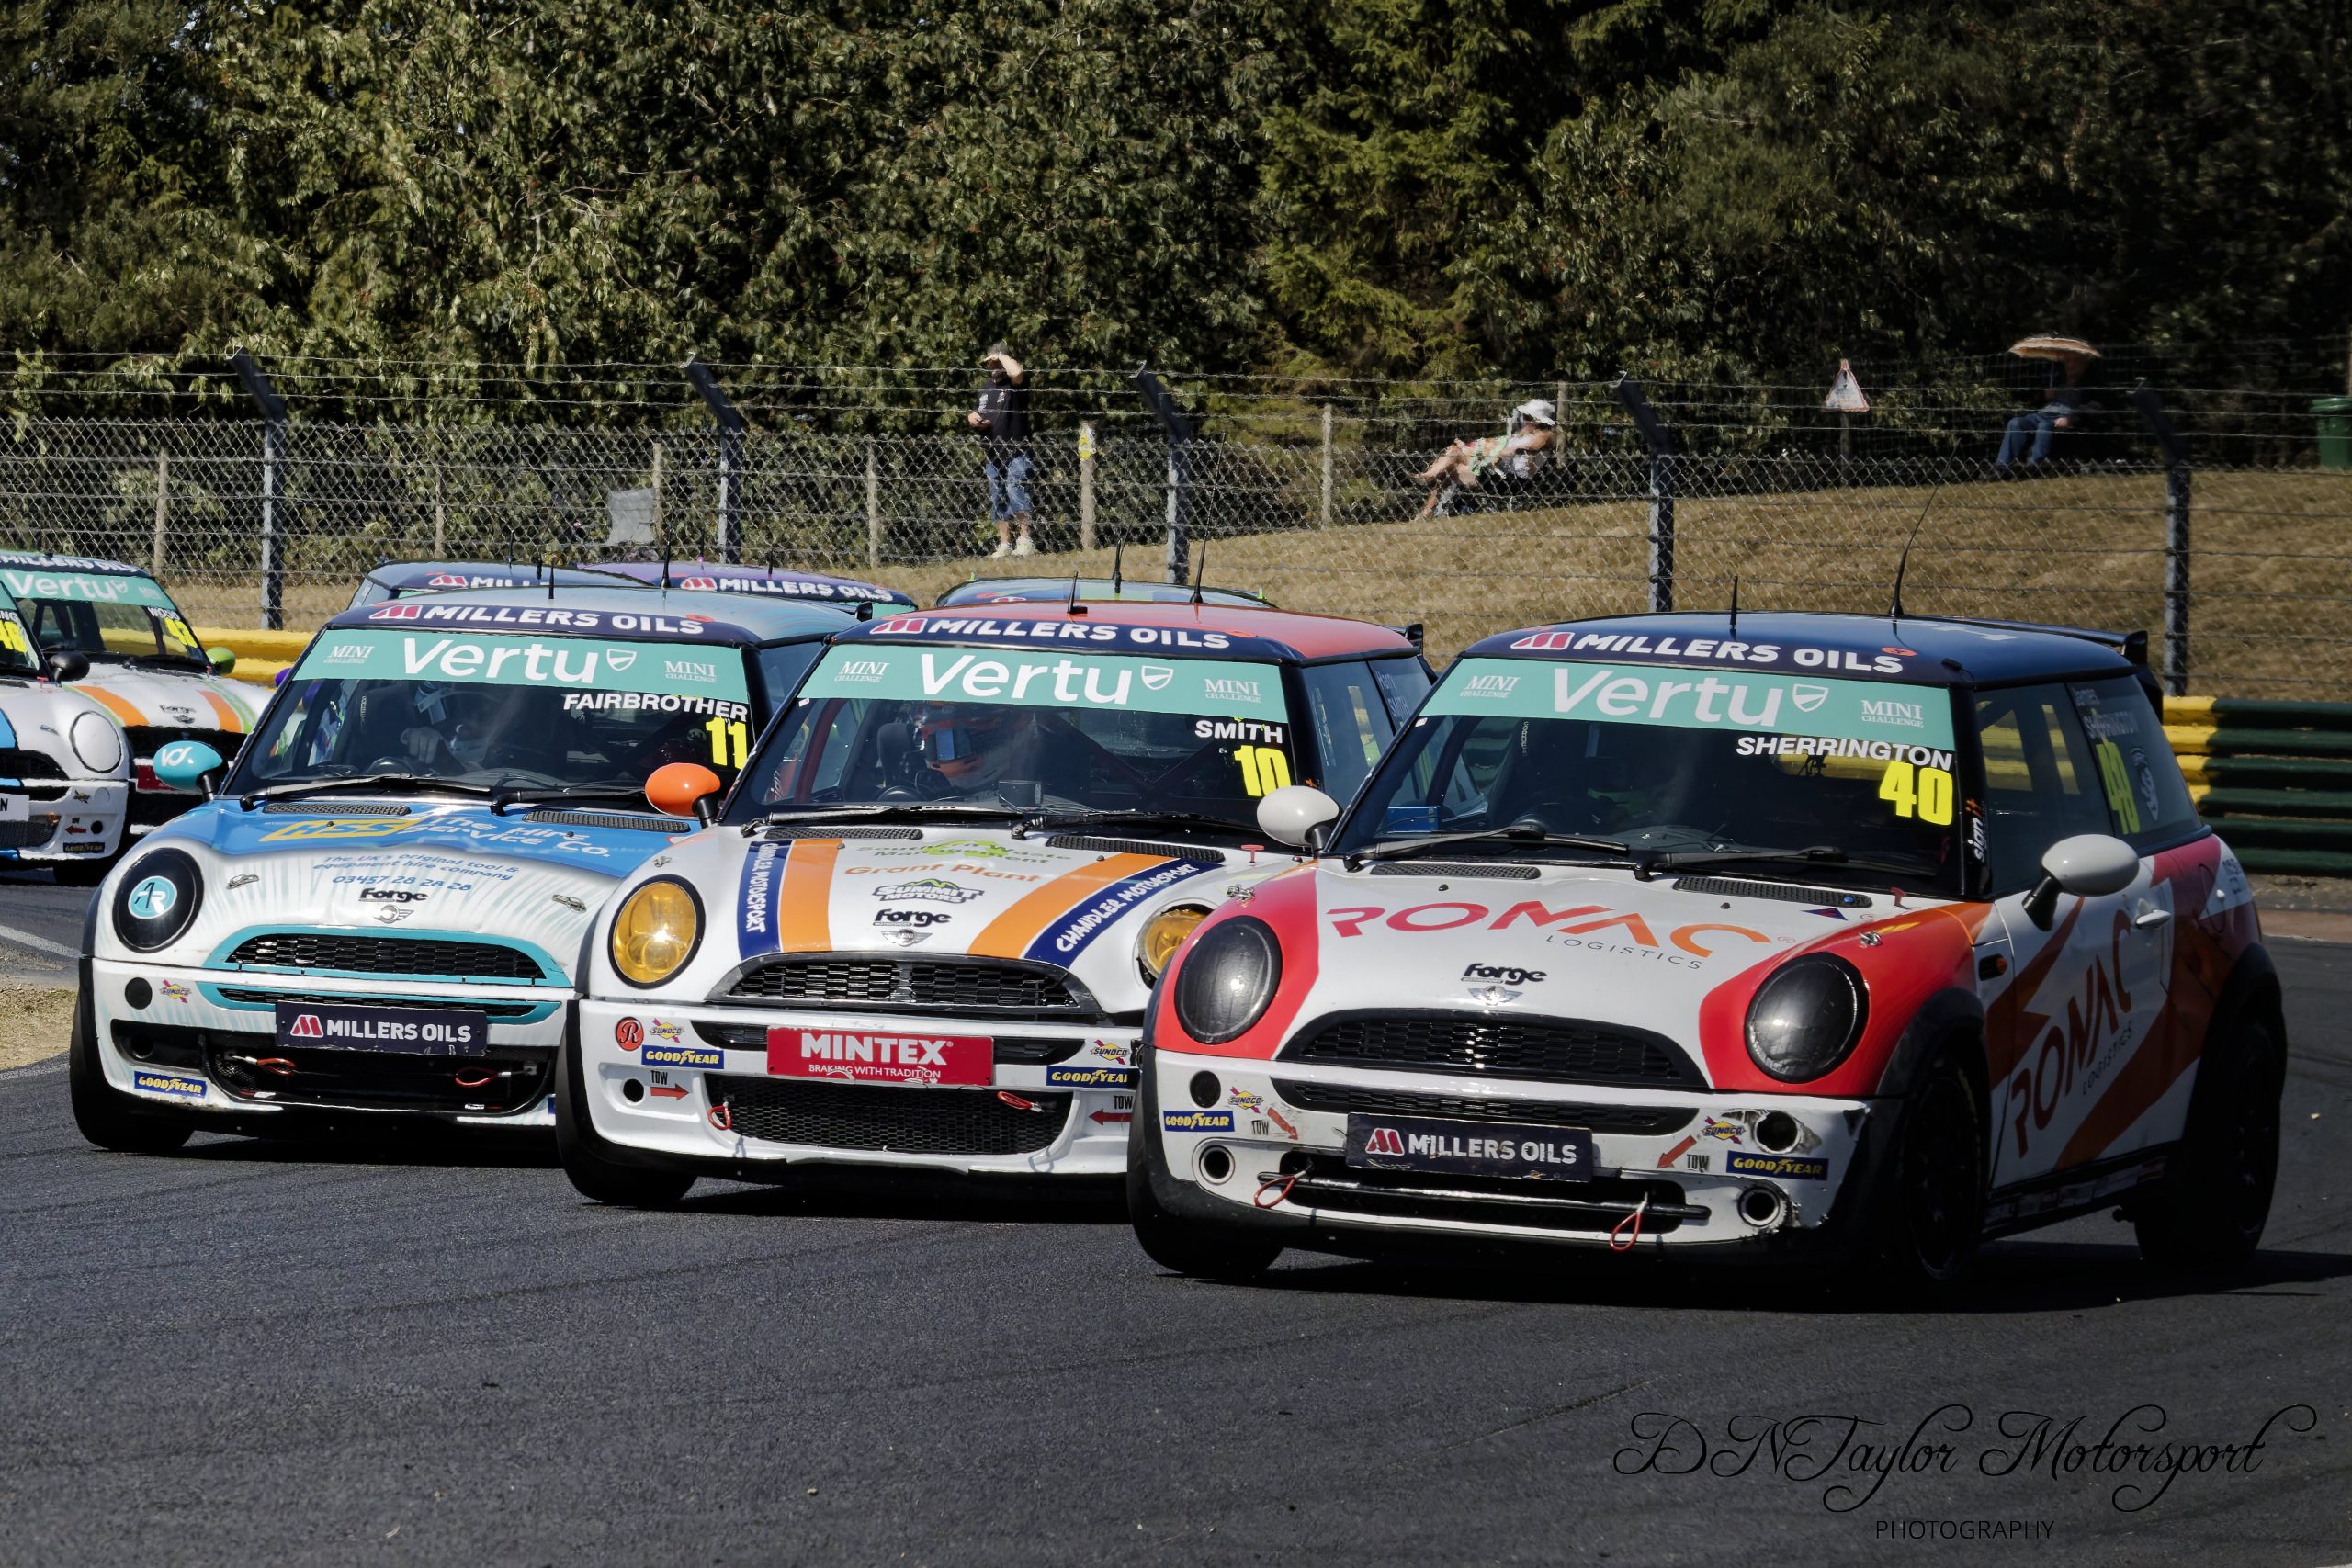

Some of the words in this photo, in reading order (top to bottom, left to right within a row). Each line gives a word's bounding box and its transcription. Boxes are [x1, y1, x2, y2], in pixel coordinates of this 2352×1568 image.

[0, 556, 94, 569] MILLERS
[6, 571, 118, 601] Vertu
[719, 578, 833, 596] MILLERS
[837, 586, 893, 602] OILS
[148, 606, 181, 621] WOOD
[424, 606, 599, 626] MILLERS
[612, 615, 704, 634] OILS
[928, 619, 1116, 640] MILLERS
[1130, 628, 1230, 649] OILS
[331, 645, 375, 659] MINI
[403, 637, 599, 683] Vertu
[1573, 634, 1781, 662] MILLERS
[1794, 649, 1904, 673] OILS
[665, 660, 717, 677] MINI
[839, 660, 890, 675] MINI
[665, 673, 717, 683] CHALLENGE
[921, 654, 1132, 705] Vertu
[1204, 678, 1260, 696] MINI
[1466, 675, 1521, 691] MINI
[1205, 693, 1261, 704] CHALLENGE
[1459, 690, 1512, 699] CHALLENGE
[1554, 668, 1783, 727] Vertu
[563, 693, 748, 722] FAIRBROTHER
[1861, 700, 1924, 720] MINI
[1861, 715, 1924, 728] CHALLENGE
[1194, 720, 1283, 744] SMITH
[706, 716, 748, 770] 11
[1736, 737, 1952, 771] SHERRINGTON
[1233, 744, 1292, 797] 10
[1879, 761, 1953, 825] 40
[283, 822, 397, 837] HSS
[429, 817, 497, 830] The
[505, 827, 590, 841] Hire
[557, 840, 610, 858] Co.
[313, 861, 399, 869] equipment
[402, 860, 436, 869] hire
[441, 867, 513, 880] company
[398, 854, 465, 865] original
[467, 862, 503, 871] tool
[845, 864, 944, 874] Grant
[950, 863, 1040, 882] Plant
[391, 876, 417, 885] 28
[421, 878, 443, 887] 28
[448, 882, 474, 891] 28
[746, 871, 771, 933] MOTORSPORT
[876, 886, 980, 900] SUMMIT
[884, 892, 967, 904] MOTORS
[1057, 899, 1128, 952] CHANDLER
[1117, 863, 1199, 902] MOTORSPORT
[1325, 900, 1773, 958] ROMAC
[1545, 936, 1703, 970] LOGISTICS
[326, 1020, 417, 1040] MILLERS
[421, 1023, 471, 1042] OILS
[619, 1020, 640, 1043] R
[646, 1051, 720, 1064] GOODYEAR
[801, 1032, 947, 1066] MINTEX
[1093, 1047, 1129, 1055] SUNOCO
[650, 1070, 669, 1085] TOW
[808, 1064, 853, 1075] BRAKING
[854, 1066, 882, 1076] WITH
[884, 1067, 941, 1078] TRADITION
[139, 1077, 202, 1093] GOODYEAR
[1114, 1095, 1134, 1110] TOW
[1165, 1113, 1229, 1130] GOODYEAR
[1251, 1119, 1270, 1135] TOW
[1704, 1126, 1744, 1134] SUNOCO
[1408, 1134, 1516, 1159] MILLERS
[1521, 1142, 1577, 1165] OILS
[1687, 1154, 1711, 1171] TOW
[1733, 1158, 1823, 1175] GOODYEAR
